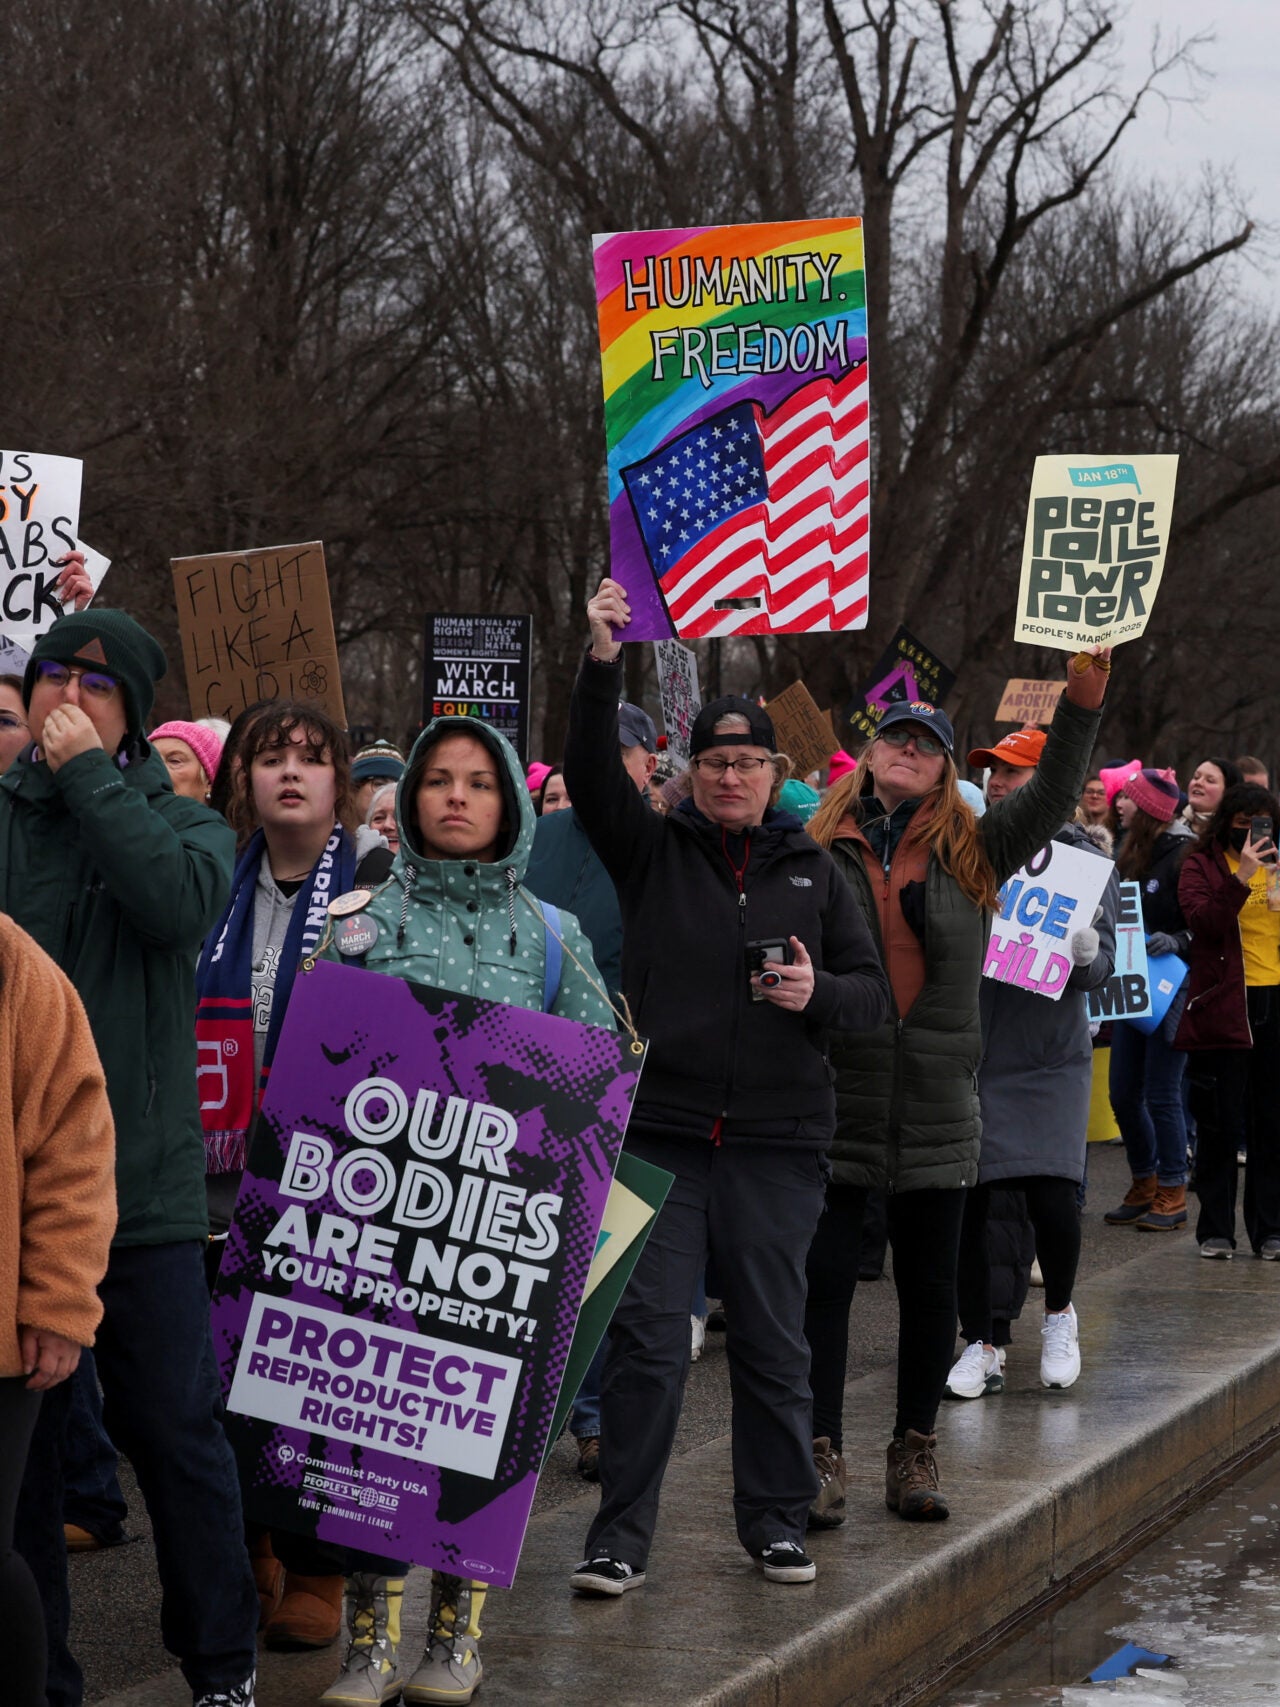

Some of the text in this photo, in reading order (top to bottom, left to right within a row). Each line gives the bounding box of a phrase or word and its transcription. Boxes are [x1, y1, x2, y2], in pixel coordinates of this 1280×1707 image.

[622, 251, 848, 311] HUMANITY.
[650, 320, 860, 390] FREEDOM.
[1077, 468, 1128, 483] JAN 18TH
[186, 551, 310, 616] FIGHT
[433, 627, 473, 637] RIGHTS
[434, 617, 473, 628] HUMAN
[474, 619, 522, 627] EQUAL PAY
[485, 627, 516, 635] BLACK
[485, 634, 512, 643] LIVES
[1021, 621, 1142, 644] PEOPLE'S MARCH 2025
[192, 609, 314, 674] LIKE A
[433, 648, 469, 656] WOMEN'S
[471, 649, 499, 657] RIGHTS
[485, 642, 522, 651] MATTER
[436, 678, 515, 697] MARCH
[444, 662, 508, 681] WHY I
[433, 702, 519, 717] EQUALITY
[850, 710, 878, 738] POW
[866, 703, 884, 721] QU
[998, 879, 1078, 940] NCE
[1117, 886, 1139, 924] E
[341, 932, 371, 945] MARCH
[1117, 927, 1141, 970] T
[983, 932, 1071, 994] HILD
[1088, 973, 1149, 1017] MB
[344, 1076, 519, 1177] OUR
[278, 1132, 563, 1261] BODIES
[262, 1205, 551, 1310] ARE NOT
[262, 1249, 538, 1344] YOUR PROPERTY!
[255, 1306, 509, 1405] PROTECT
[247, 1351, 497, 1438] REPRODUCTIVE
[299, 1399, 428, 1452] RIGHTS!
[296, 1452, 428, 1497] Communist Party USA
[303, 1475, 349, 1495] PEOPLE'S
[298, 1497, 321, 1512] YOUNG
[322, 1503, 366, 1523] COMMUNIST
[367, 1512, 394, 1531] LEAGUE
